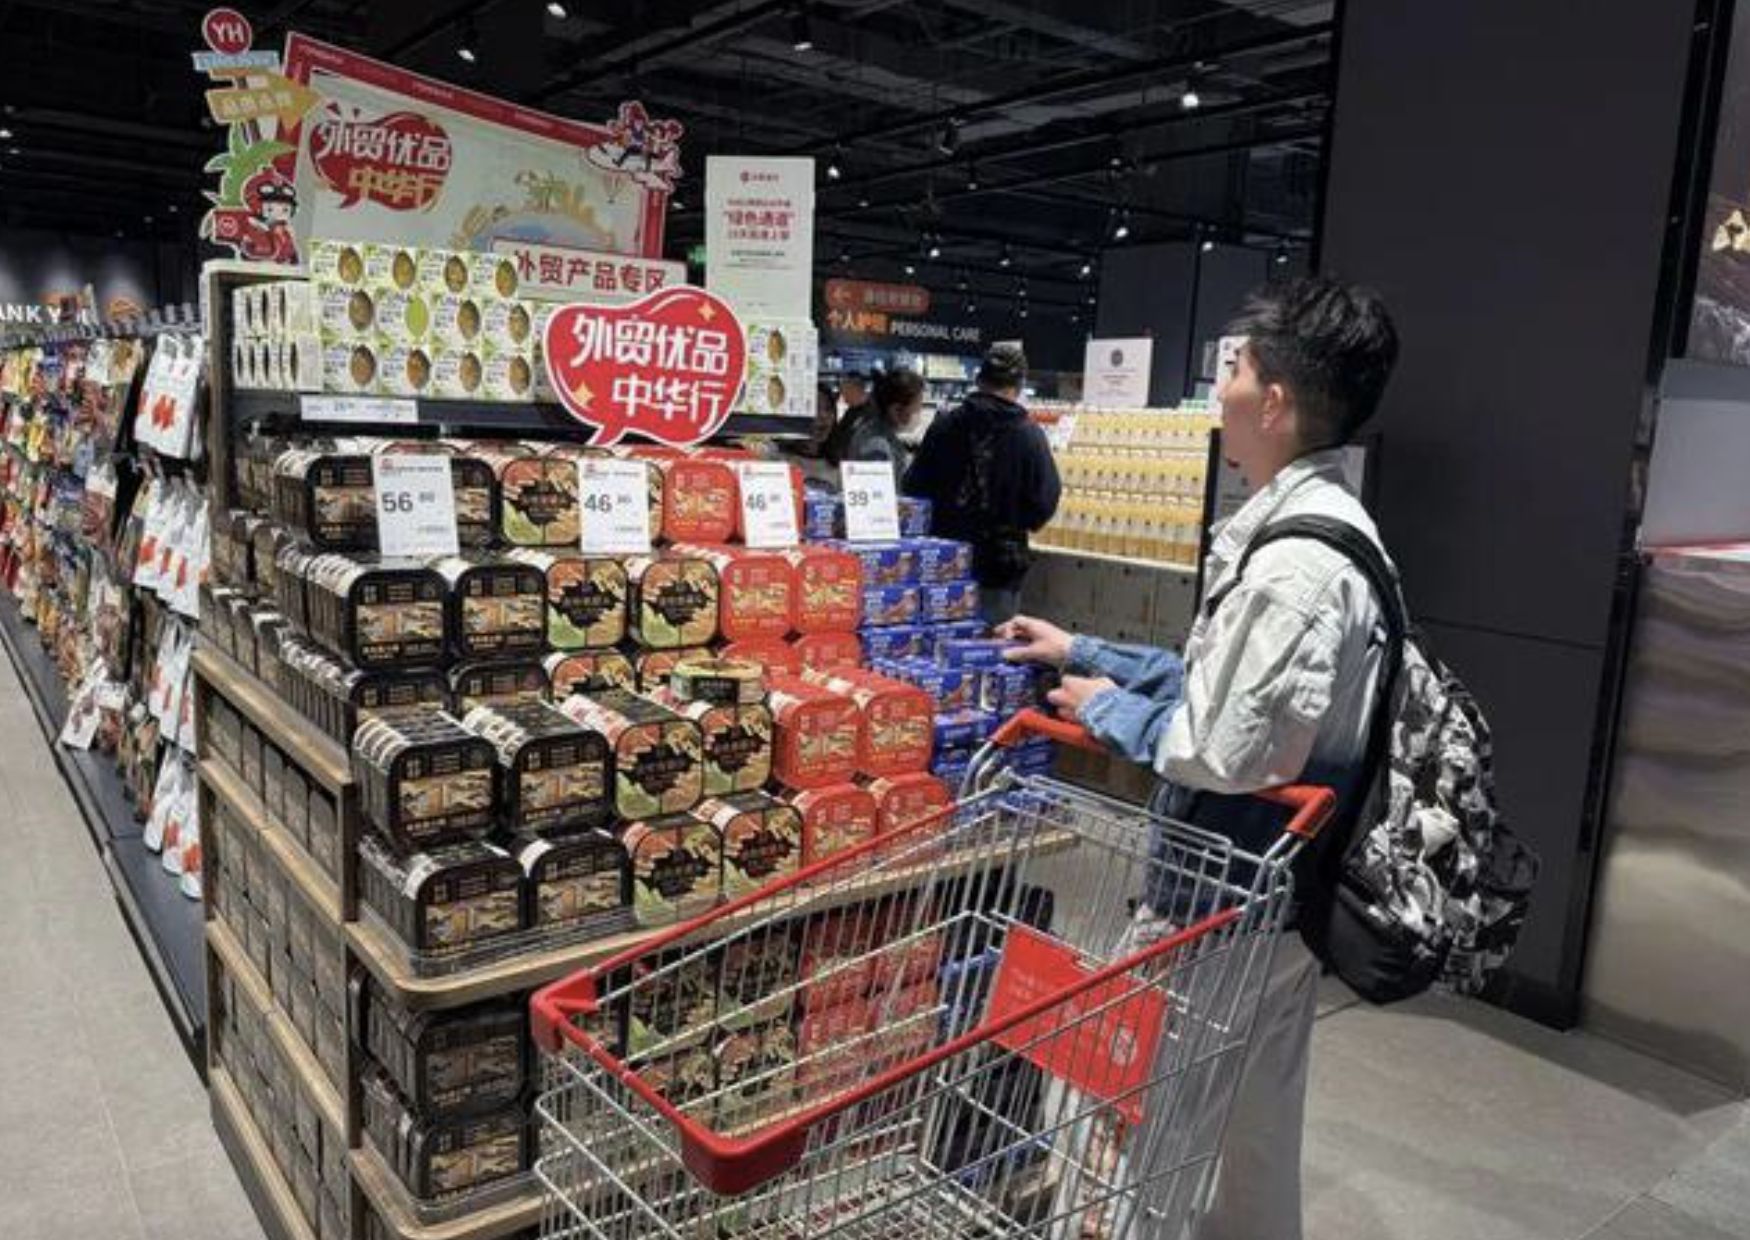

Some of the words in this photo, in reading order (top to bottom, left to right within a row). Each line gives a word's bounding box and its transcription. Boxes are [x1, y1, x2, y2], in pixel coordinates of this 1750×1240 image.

[211, 22, 244, 43] YH
[315, 119, 449, 170] 外贸优品
[515, 250, 666, 292] 外贸产品专区
[890, 320, 949, 340] PERSONAL
[952, 326, 980, 341] CARE
[571, 312, 730, 376] 外贸优品
[612, 372, 728, 434] 中华行
[382, 491, 413, 512] 56
[584, 494, 613, 513] 46
[847, 491, 868, 507] 39
